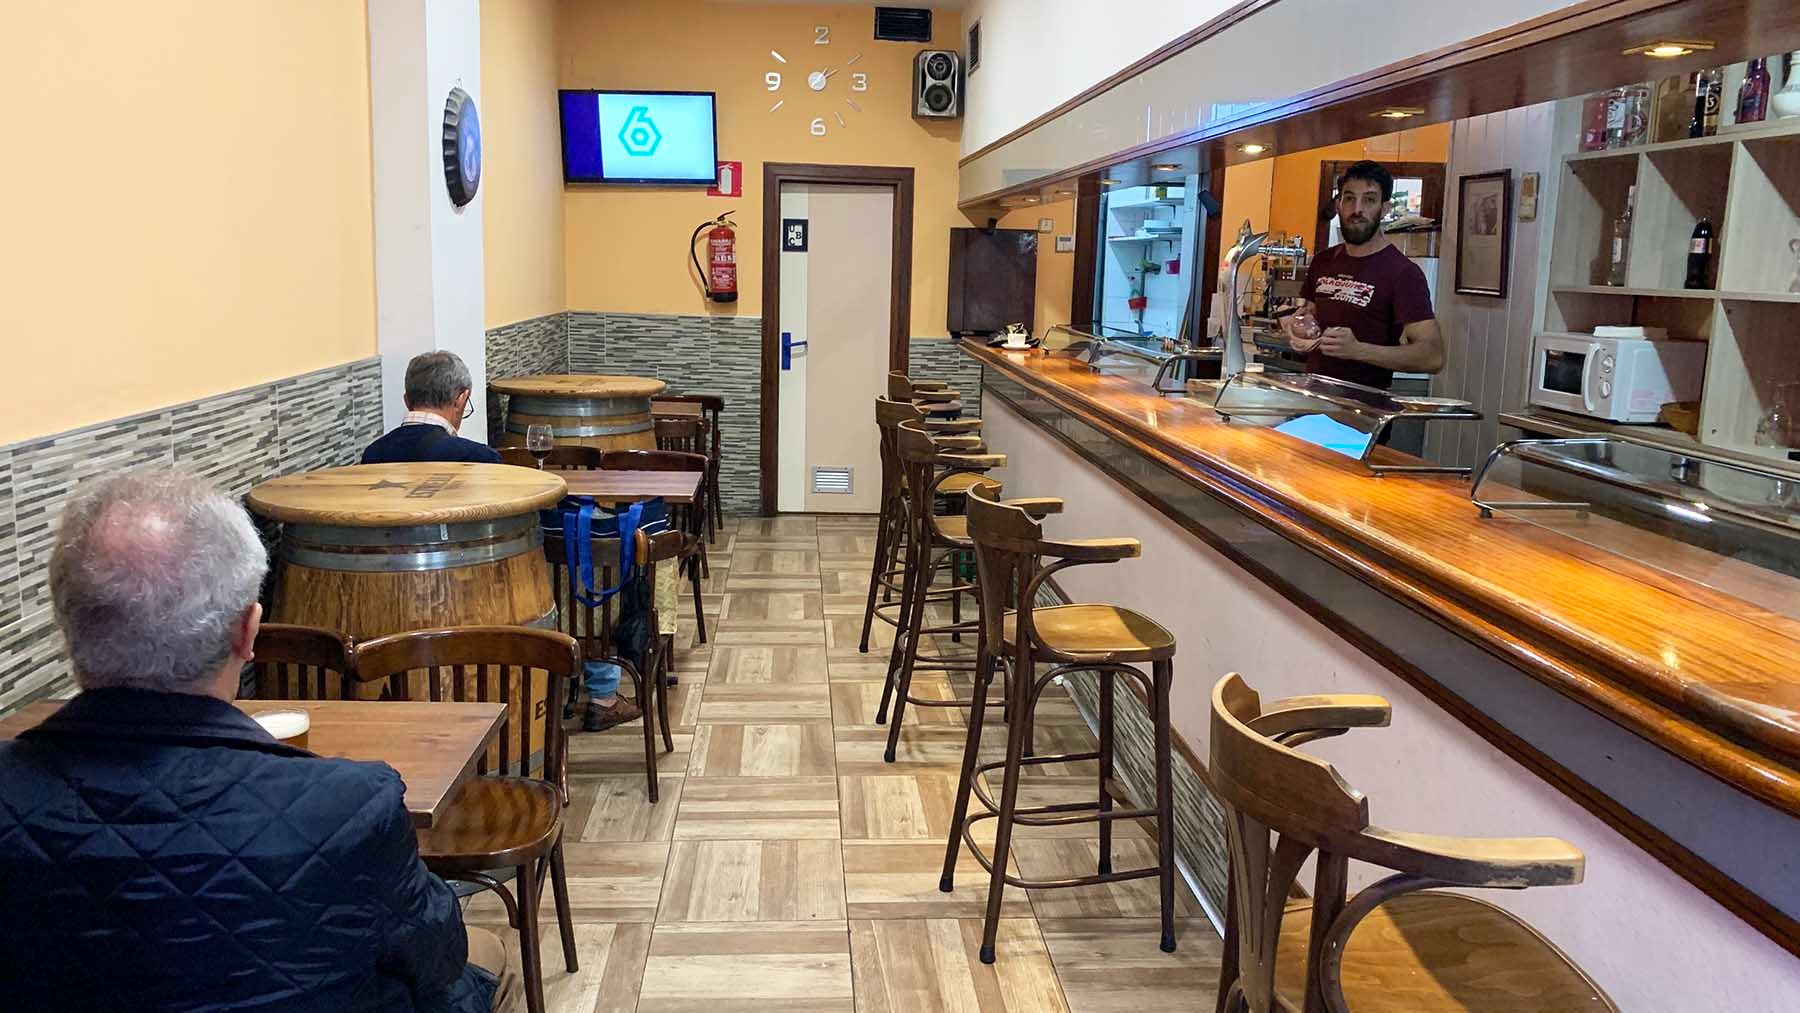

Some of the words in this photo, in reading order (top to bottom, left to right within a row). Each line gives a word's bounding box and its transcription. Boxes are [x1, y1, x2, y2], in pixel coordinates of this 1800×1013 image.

[815, 26, 830, 45] 2
[765, 72, 781, 91] 9
[852, 73, 867, 91] 3
[618, 106, 662, 157] 6
[810, 118, 826, 136] 6
